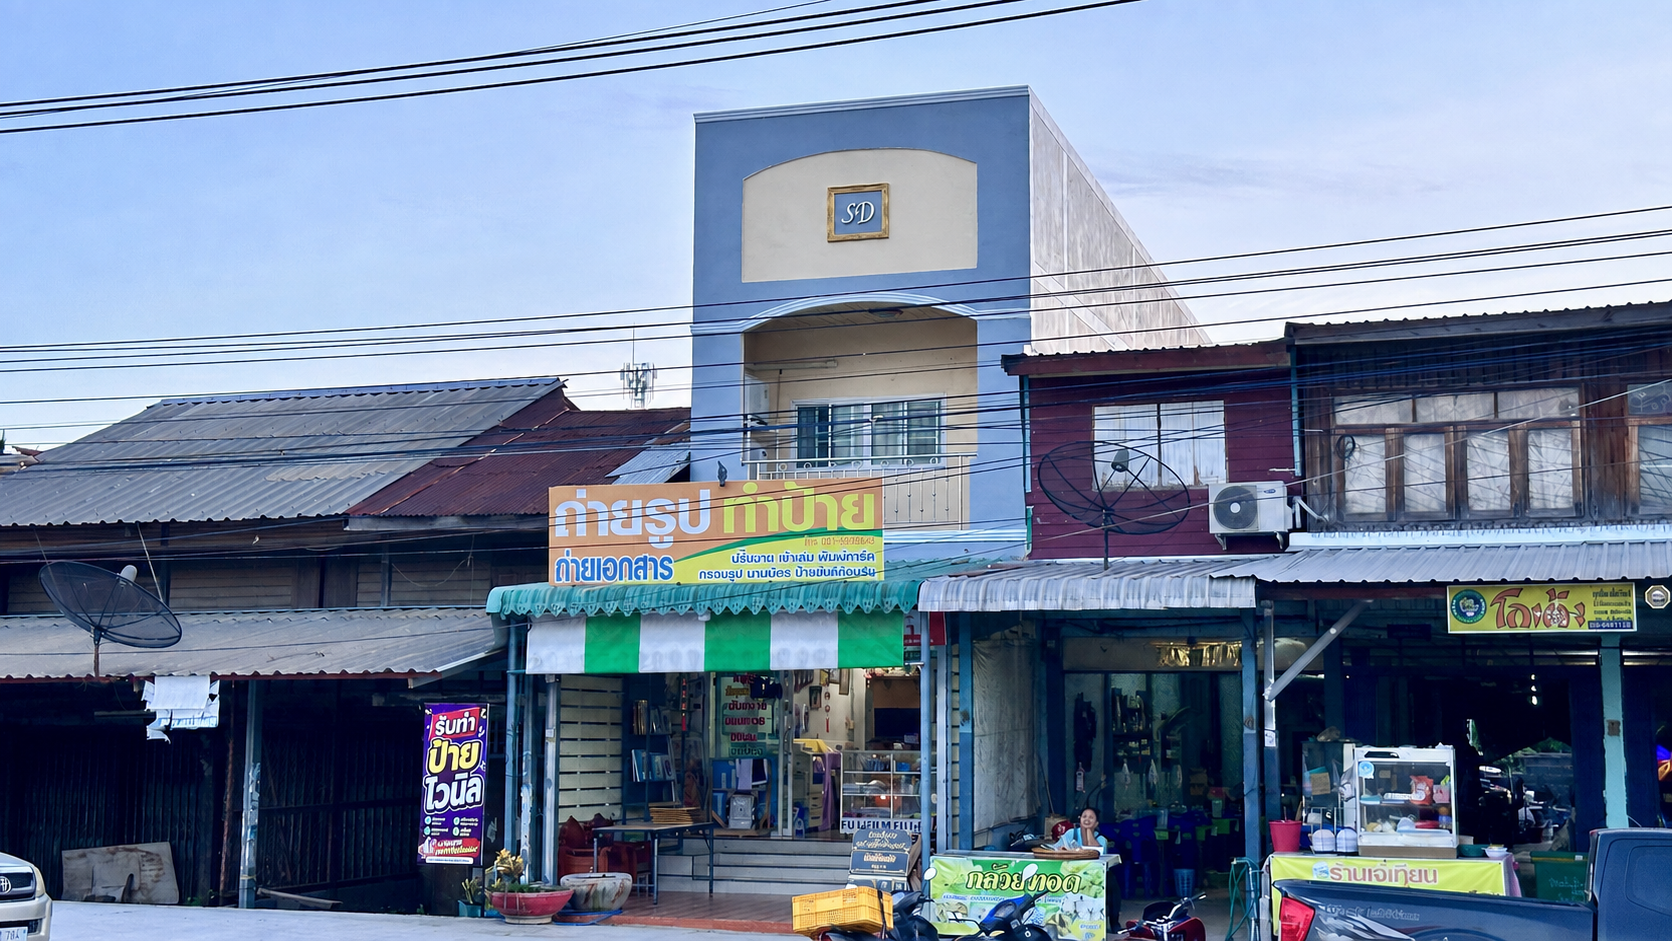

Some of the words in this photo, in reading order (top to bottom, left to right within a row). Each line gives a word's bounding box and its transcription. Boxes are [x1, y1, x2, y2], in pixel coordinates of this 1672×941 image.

[841, 201, 875, 225] SD
[554, 488, 711, 549] ถ่ายรูป
[723, 481, 875, 533] ทำป้าย
[555, 549, 674, 582] ถ่ายเอกสาร
[699, 569, 743, 582] กรอบรูป
[435, 711, 476, 736] รับทำ
[429, 739, 480, 774] ป้าย
